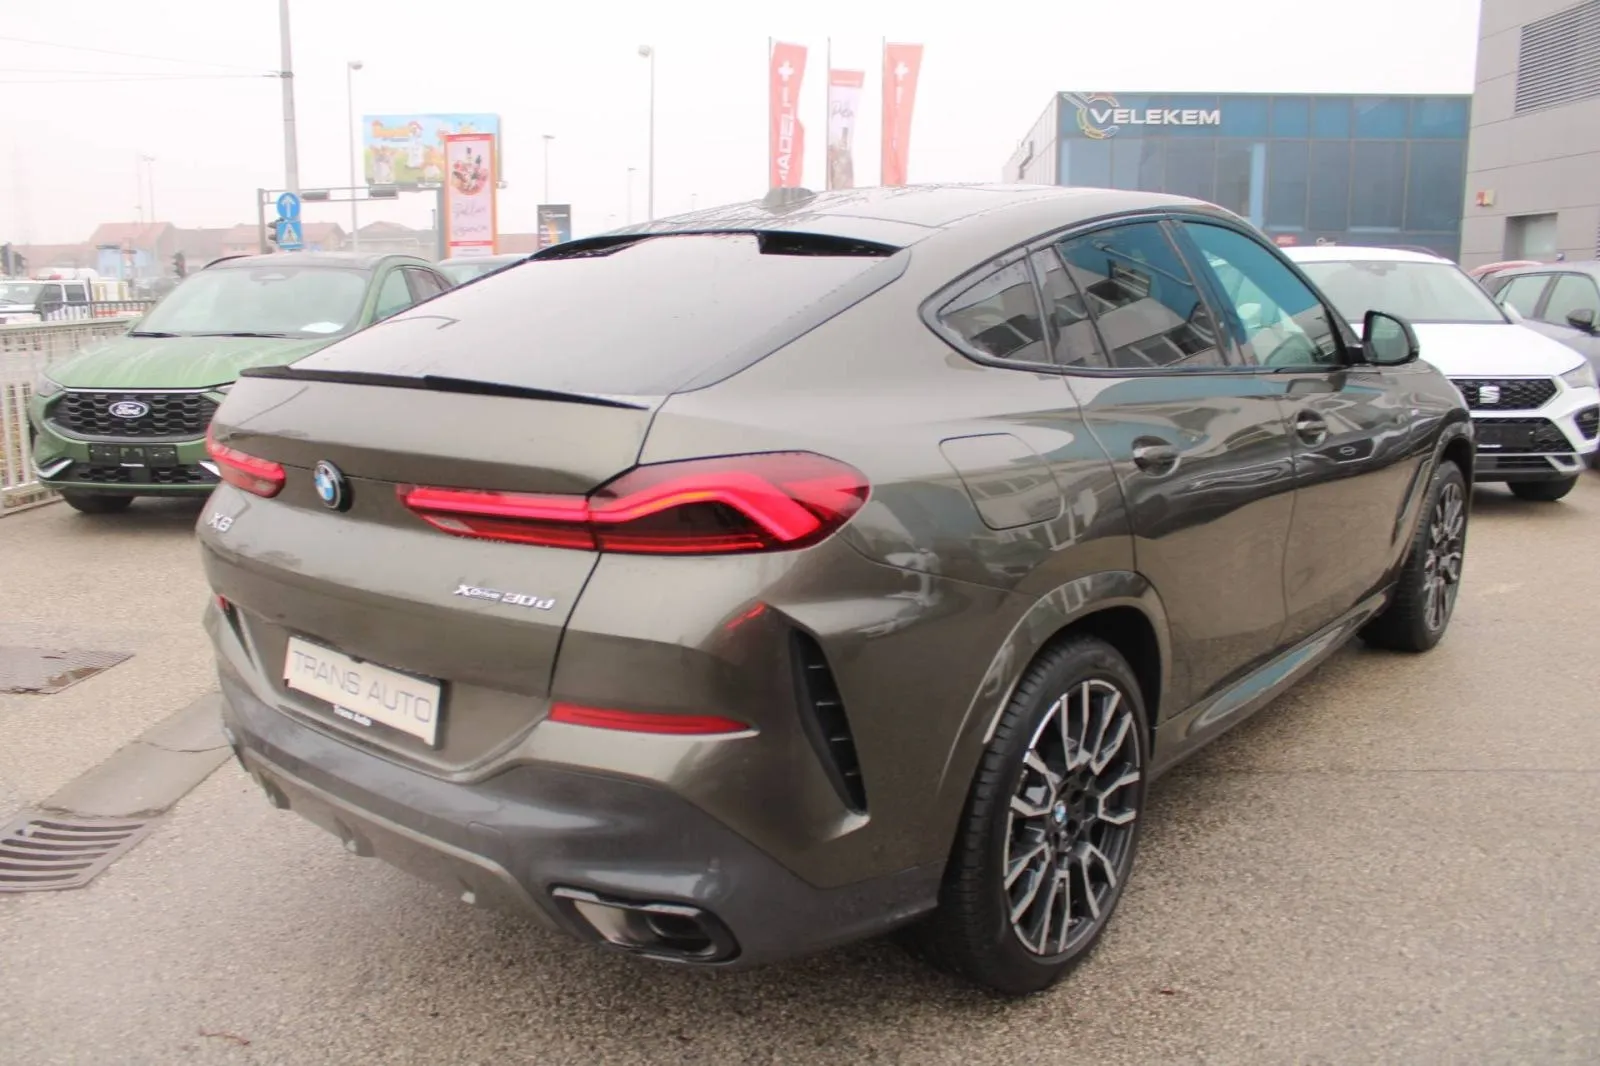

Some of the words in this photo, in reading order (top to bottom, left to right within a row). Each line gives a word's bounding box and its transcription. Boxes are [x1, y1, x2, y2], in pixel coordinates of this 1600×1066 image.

[1090, 108, 1220, 125] VELEKEM
[208, 512, 233, 532] X6
[293, 650, 360, 696] TRANS
[367, 680, 432, 723] AUTO
